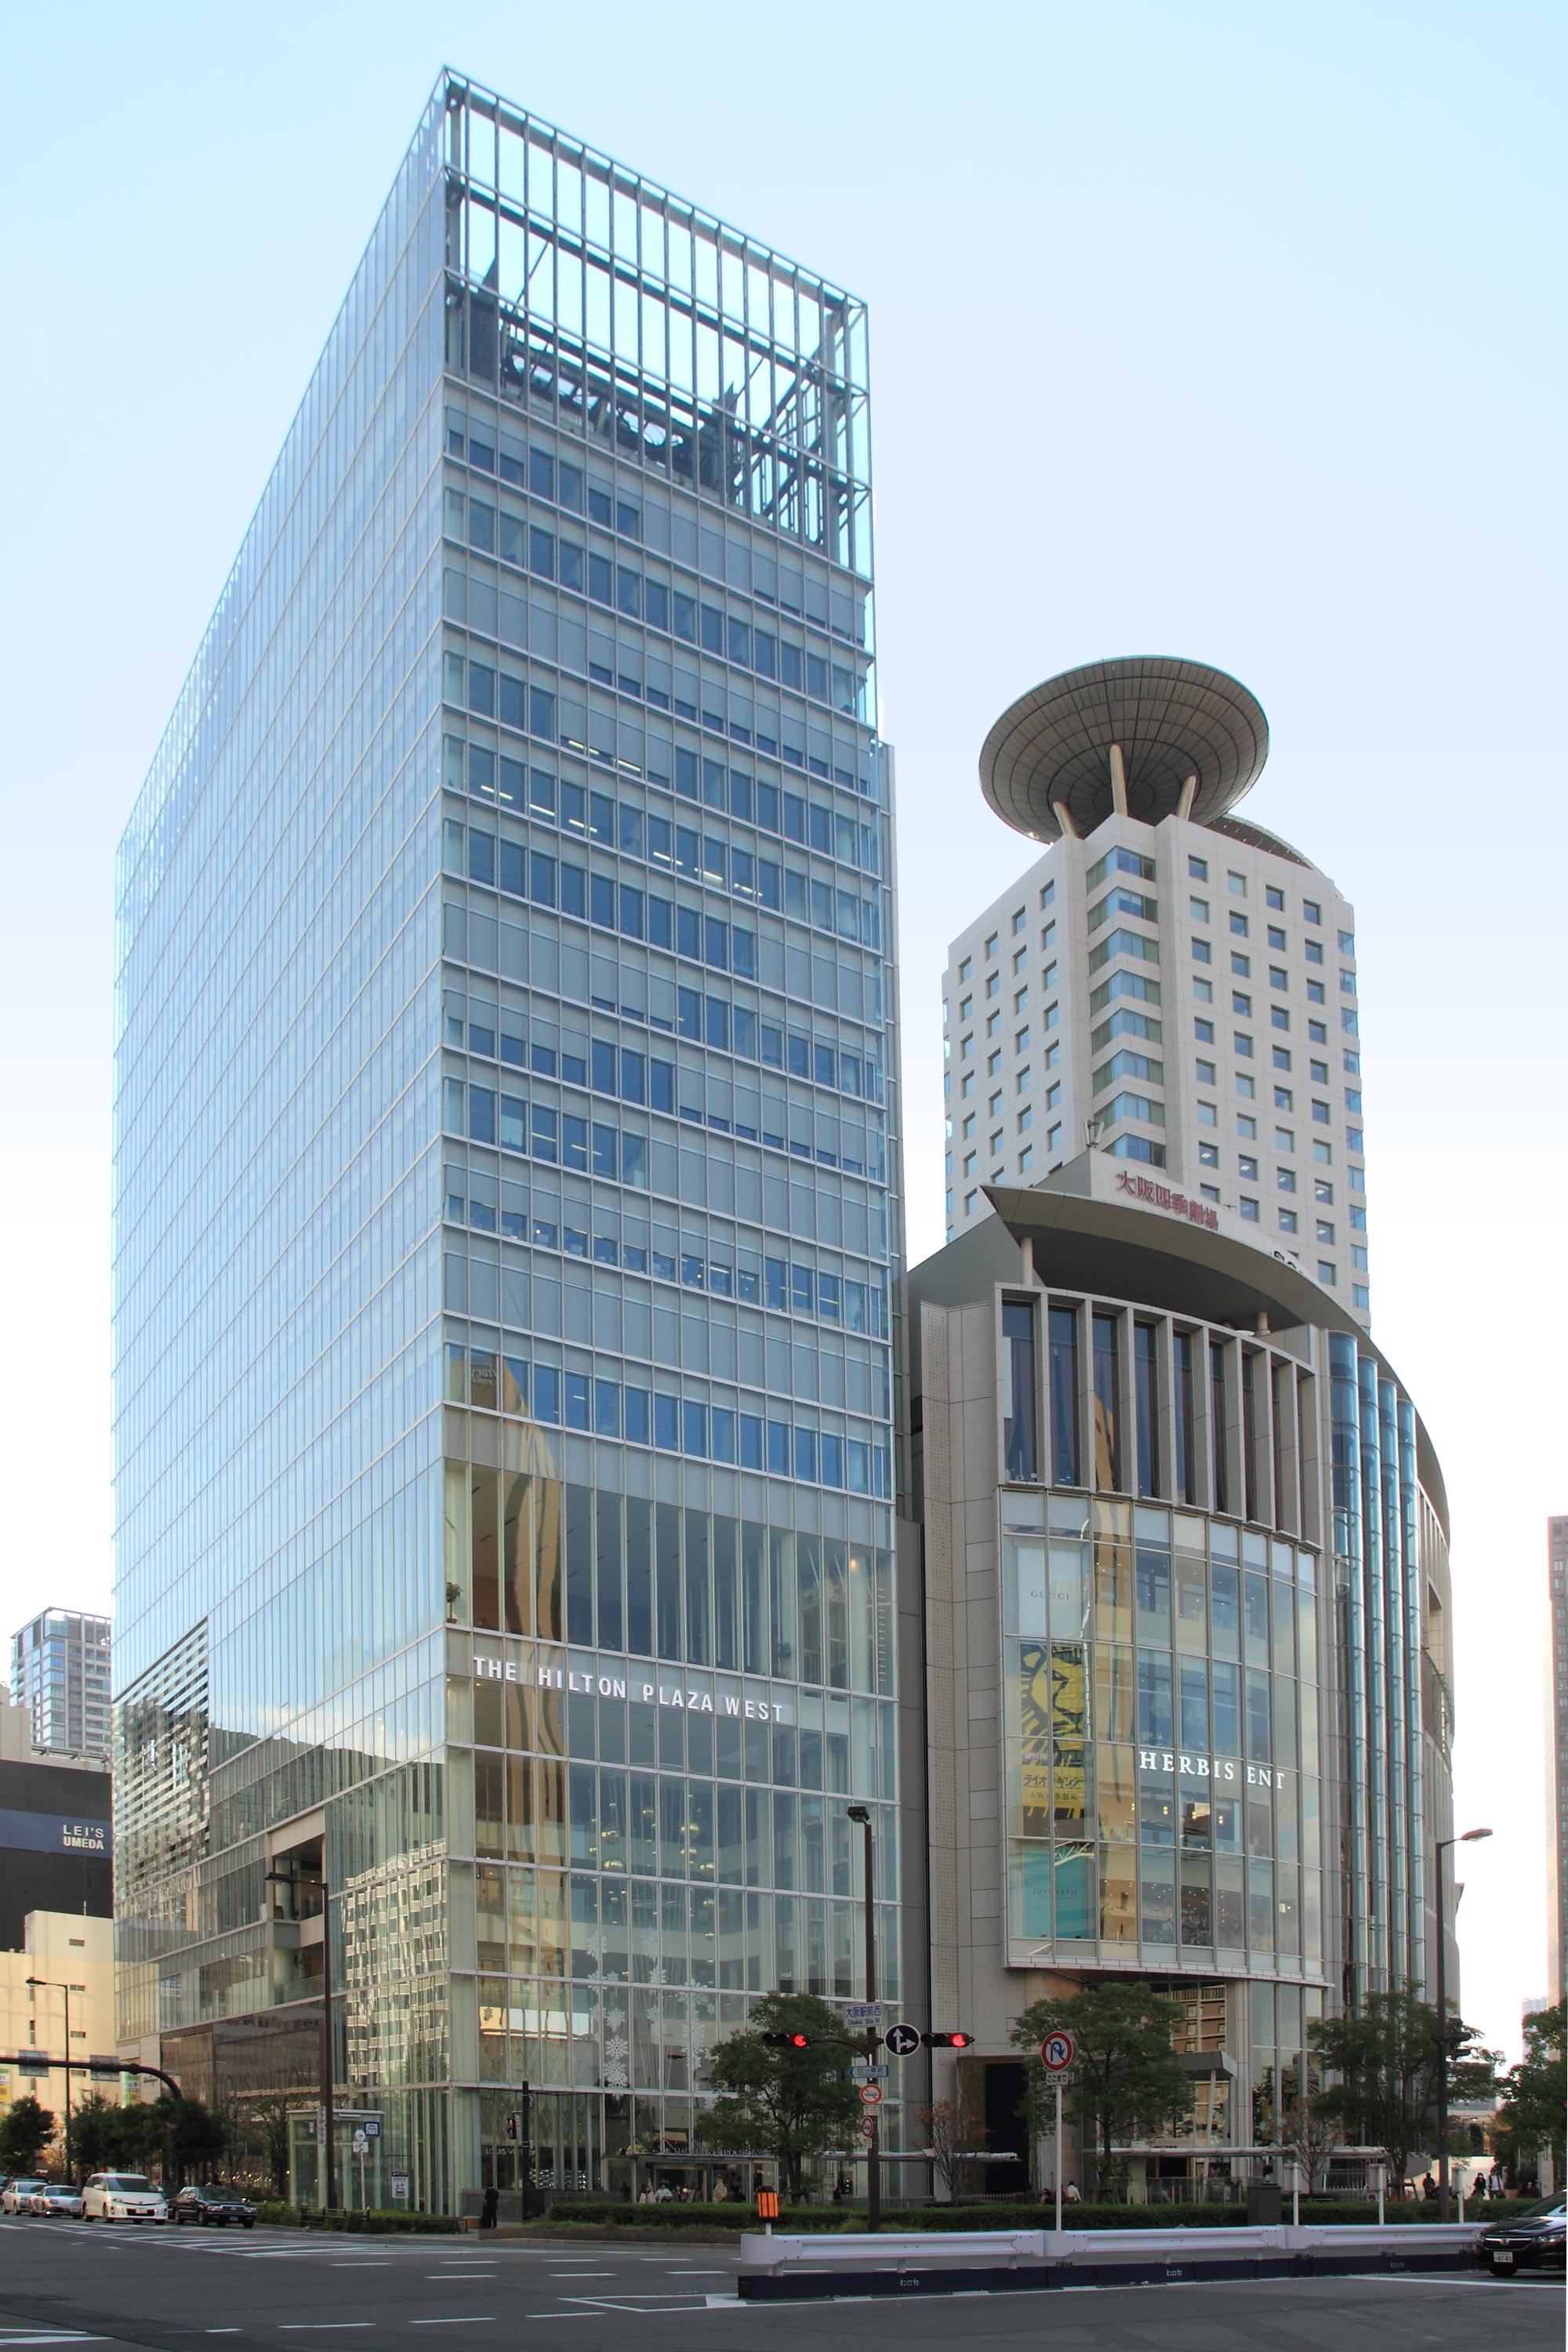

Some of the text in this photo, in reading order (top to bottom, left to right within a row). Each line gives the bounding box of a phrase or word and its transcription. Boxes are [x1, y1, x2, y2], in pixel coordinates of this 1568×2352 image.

[1116, 1170, 1218, 1231] 大阪四季劇場
[1030, 1590, 1069, 1600] GUCCI
[474, 1657, 782, 1722] THE HILTON PLAZA WEST
[1139, 1751, 1285, 1789] HERBIS ENT
[1024, 1773, 1083, 1788] ライオキング
[64, 1836, 104, 1849] UMEDA
[846, 2005, 880, 2017] 大阪駅前西
